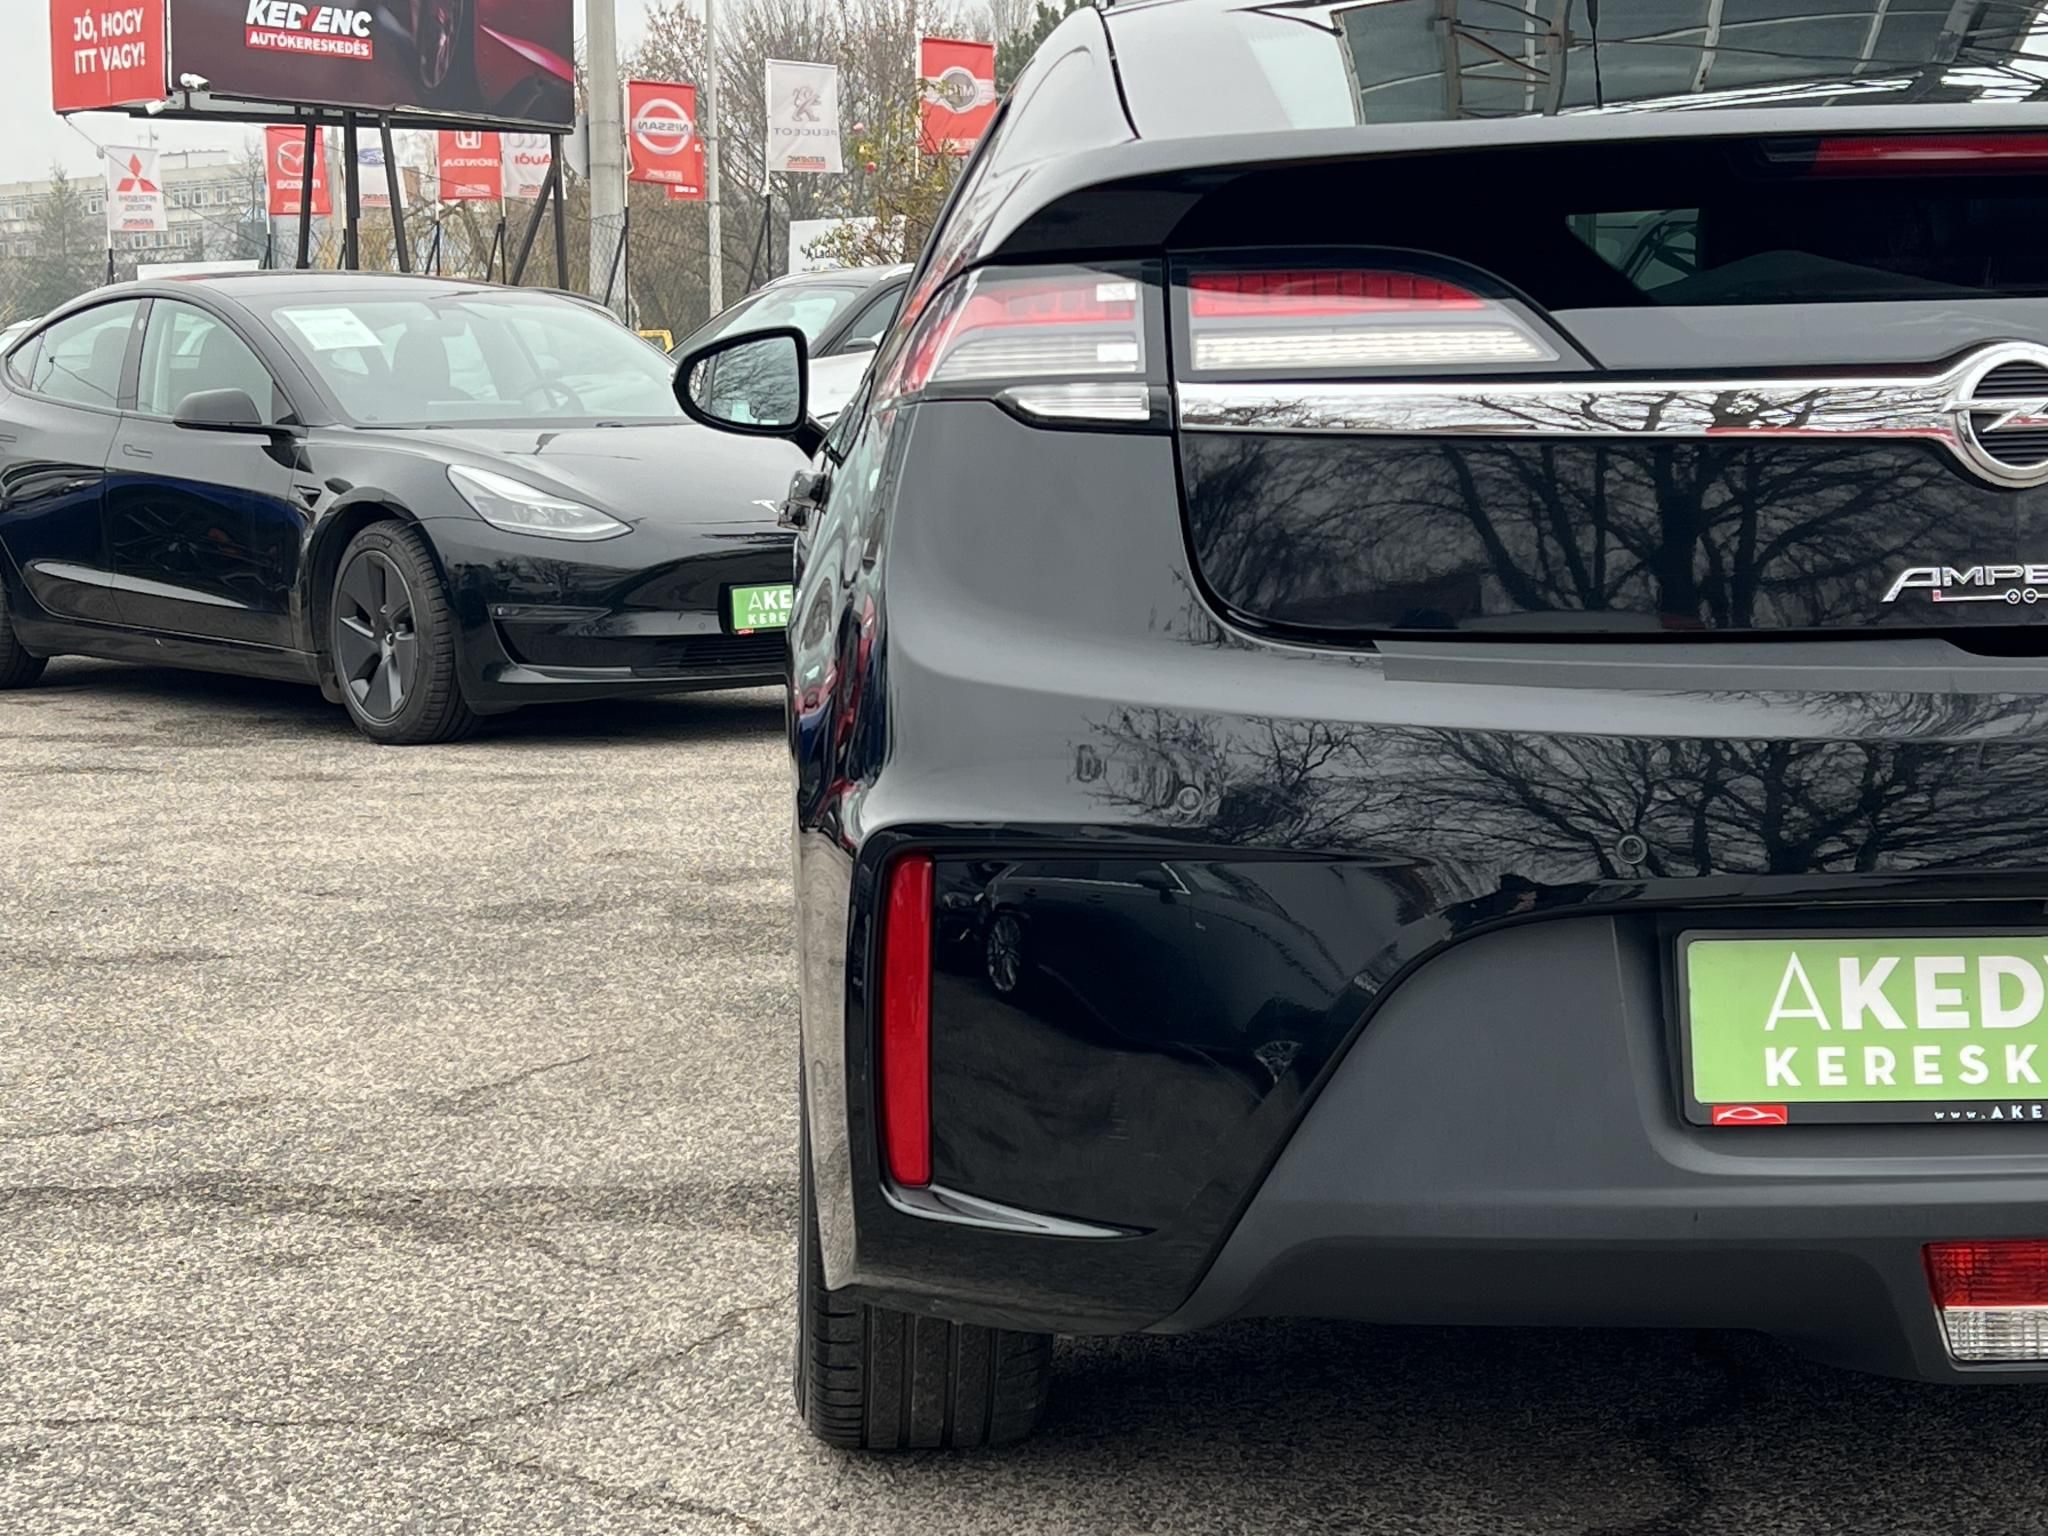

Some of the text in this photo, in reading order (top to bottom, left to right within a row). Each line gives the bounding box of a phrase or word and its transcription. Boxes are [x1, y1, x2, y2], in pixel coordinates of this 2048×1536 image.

[73, 7, 144, 44] JÓ, HOGY
[246, 0, 372, 37] KEDVENC
[74, 41, 146, 75] ITT VAGY!
[250, 31, 370, 56] AUTÓKERESKEDÉS
[1764, 951, 2048, 1031] AKED
[1764, 1044, 2042, 1087] KERESK
